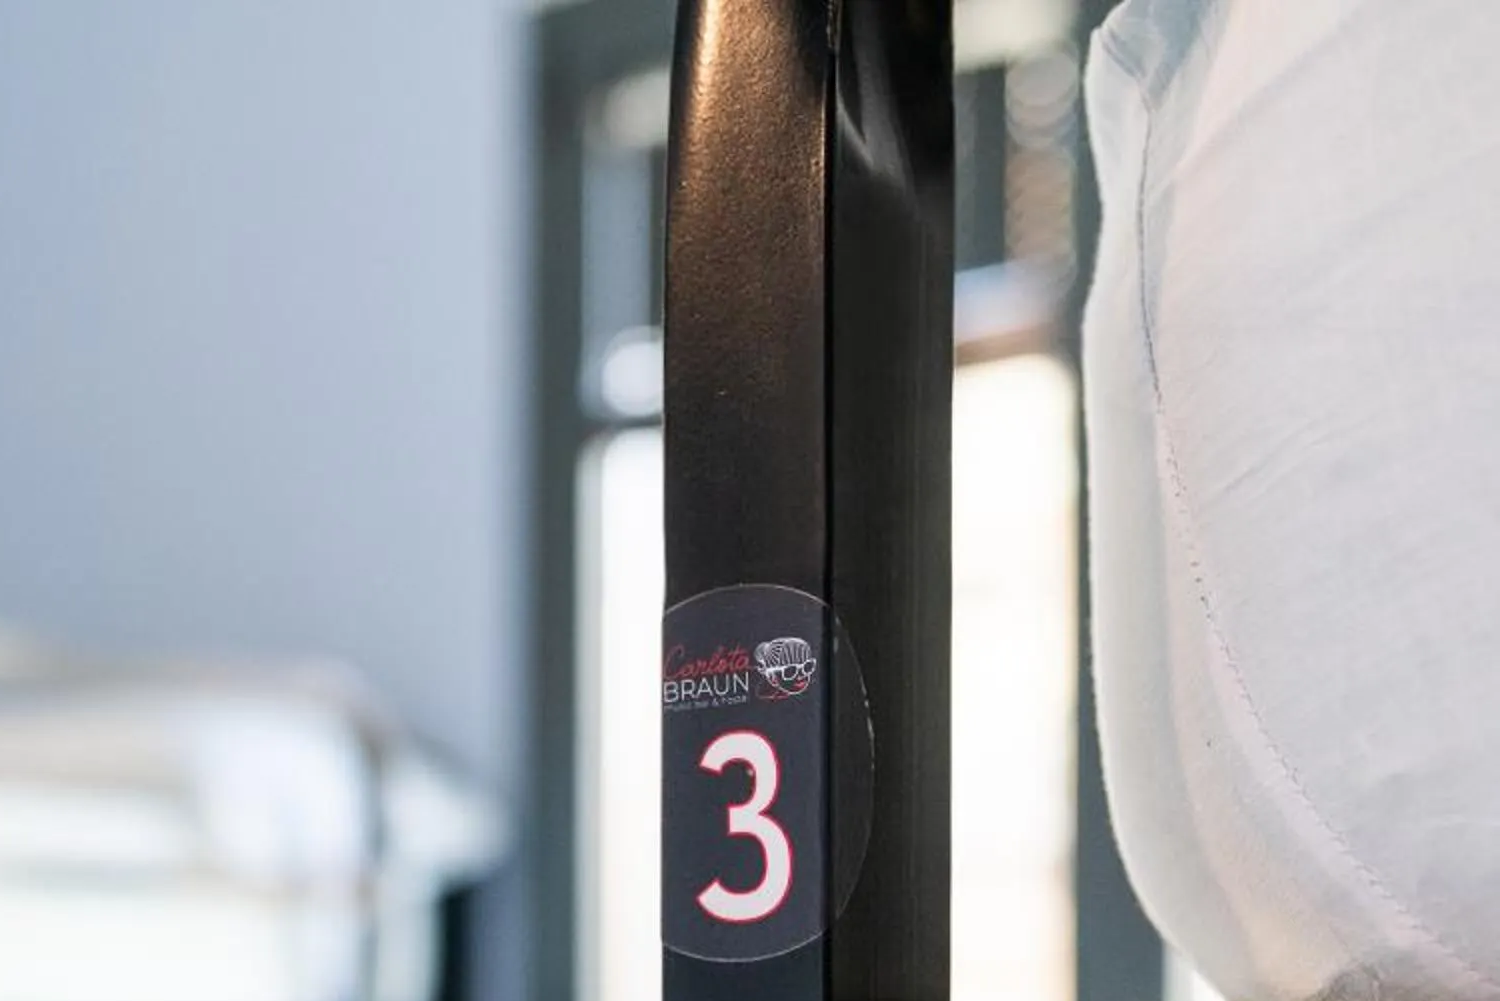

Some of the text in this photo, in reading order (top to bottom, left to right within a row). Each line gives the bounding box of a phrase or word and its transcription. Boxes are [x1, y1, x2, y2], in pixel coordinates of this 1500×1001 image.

[664, 644, 750, 680] Carlota
[663, 671, 749, 703] BRAUN
[697, 730, 792, 922] 3
